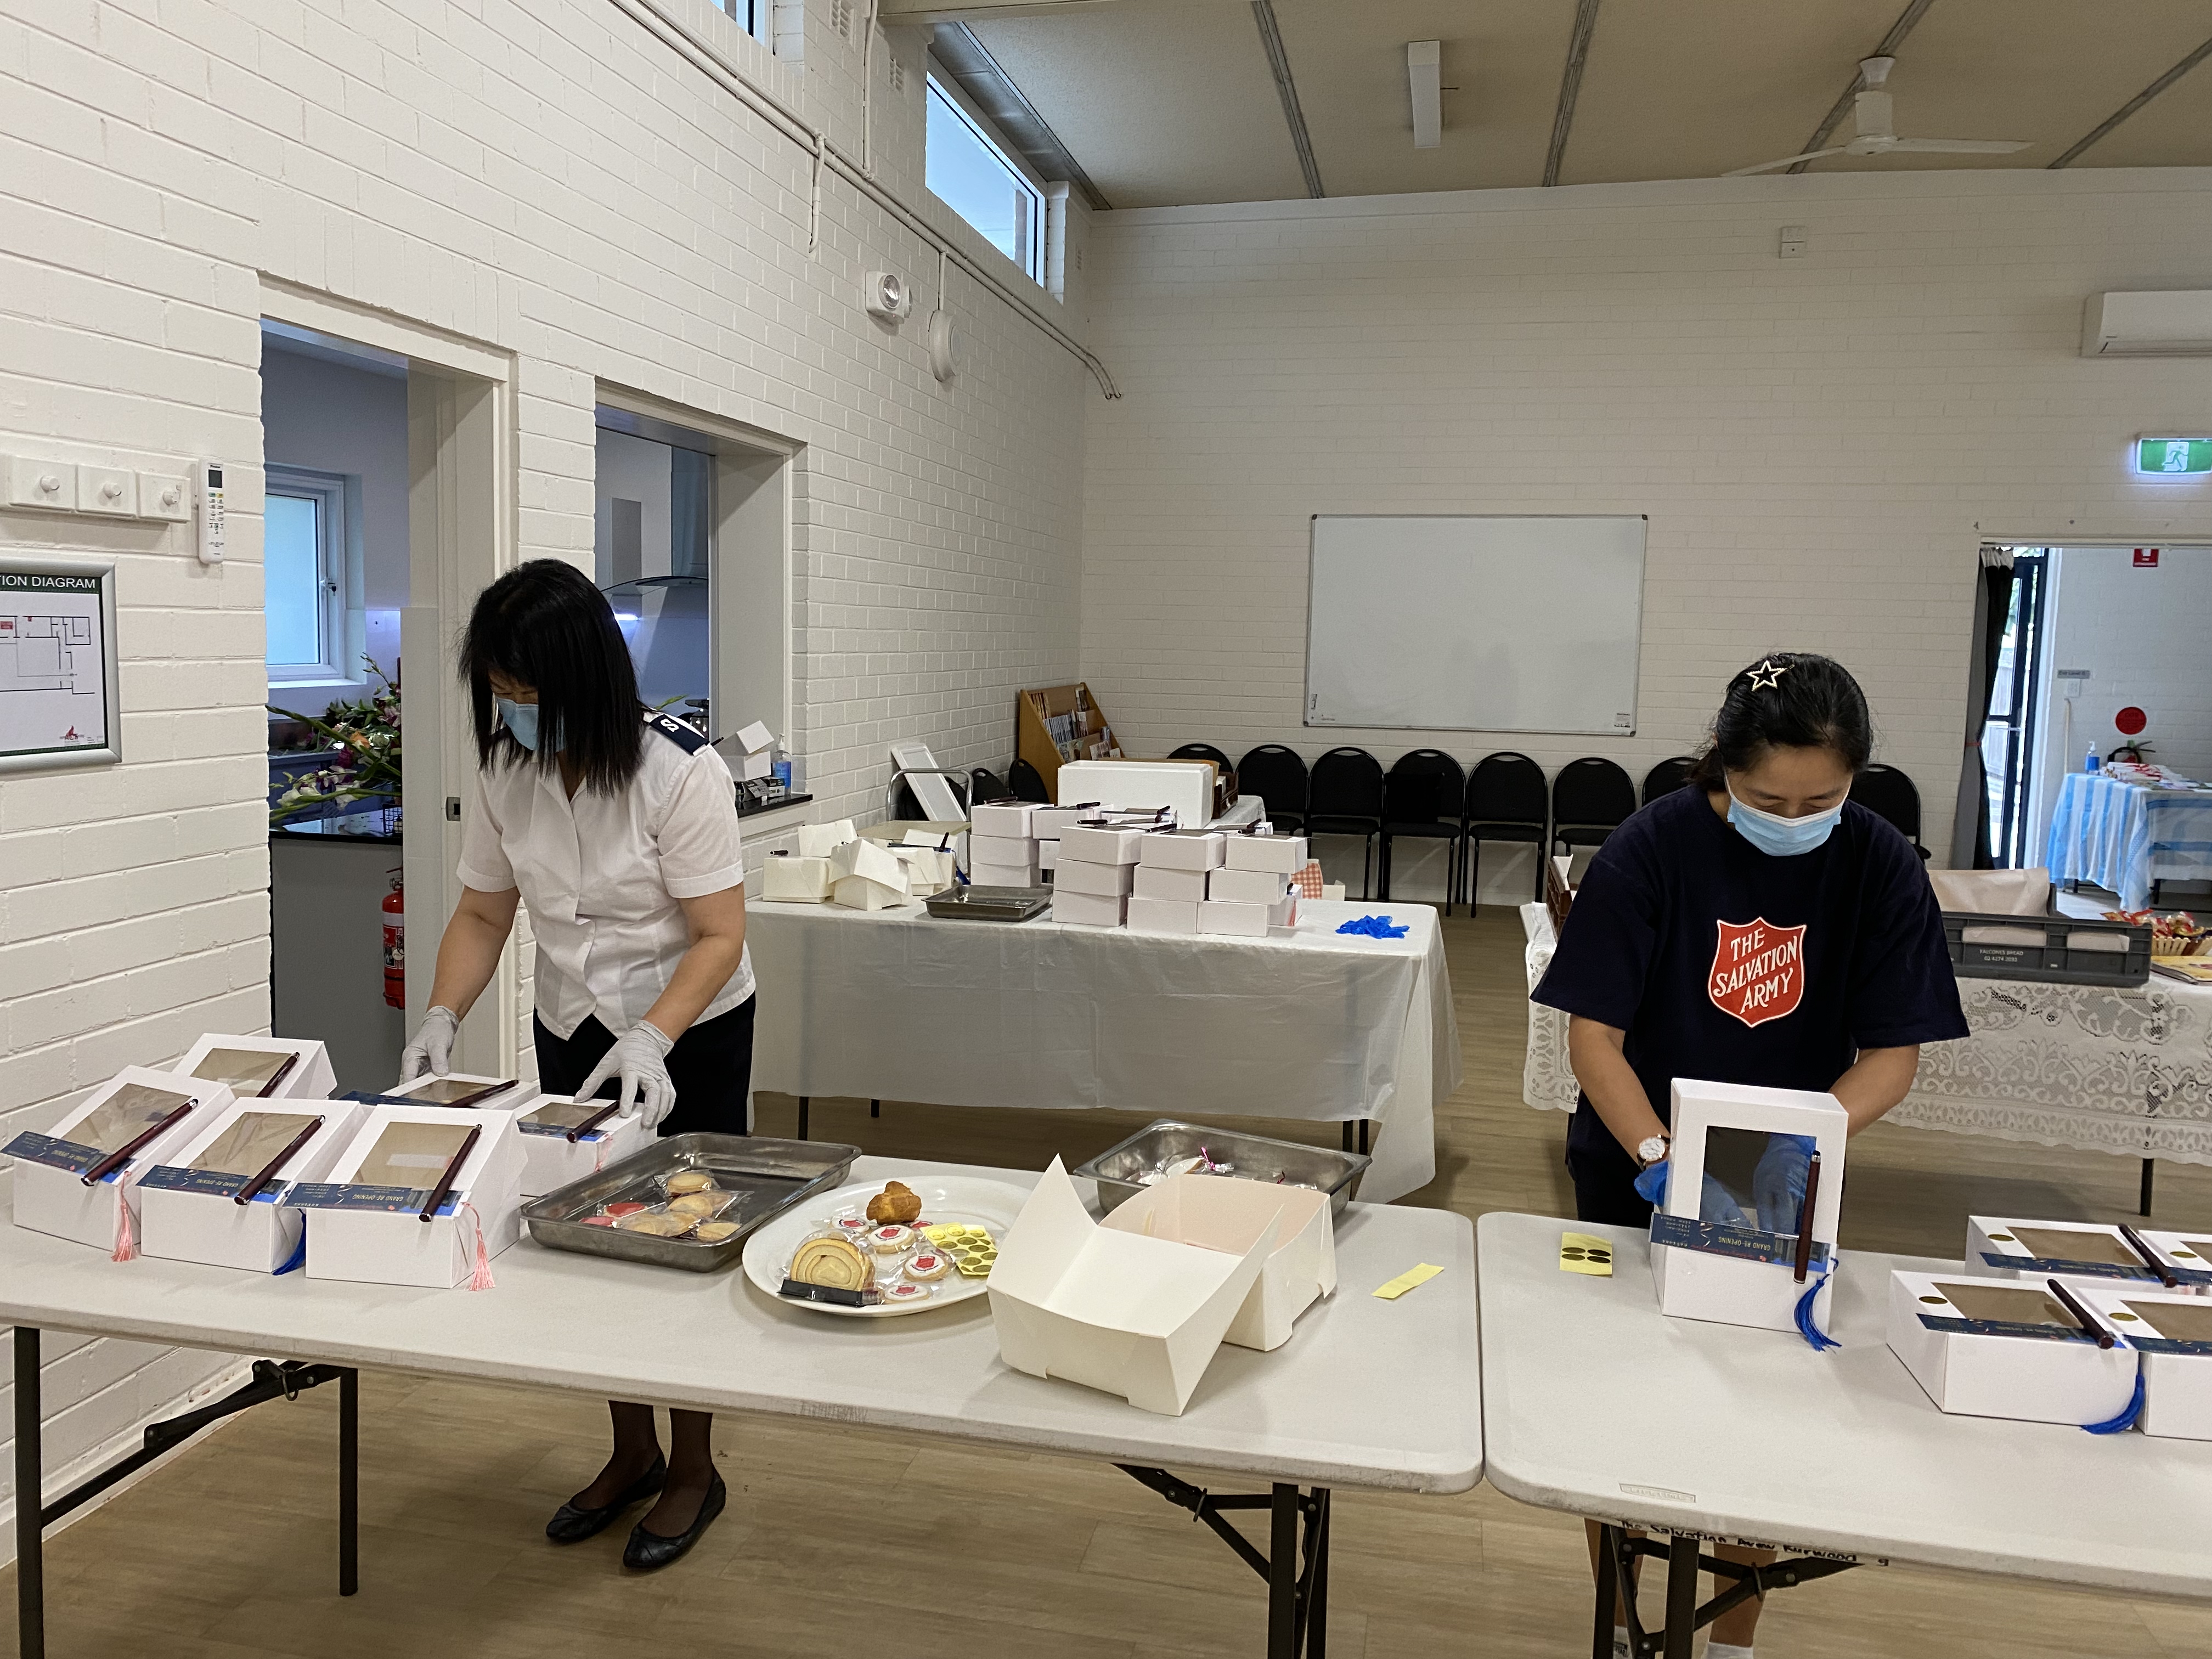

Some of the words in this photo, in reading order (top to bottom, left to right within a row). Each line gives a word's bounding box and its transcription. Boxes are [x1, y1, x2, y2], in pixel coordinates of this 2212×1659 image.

[32, 576, 95, 588] DIAGRAM
[660, 718, 679, 732] S
[1730, 927, 1765, 962] THE
[1713, 935, 1797, 997] SALVATION
[1739, 967, 1793, 1014] ARMY
[1752, 1242, 1771, 1251] GRAND
